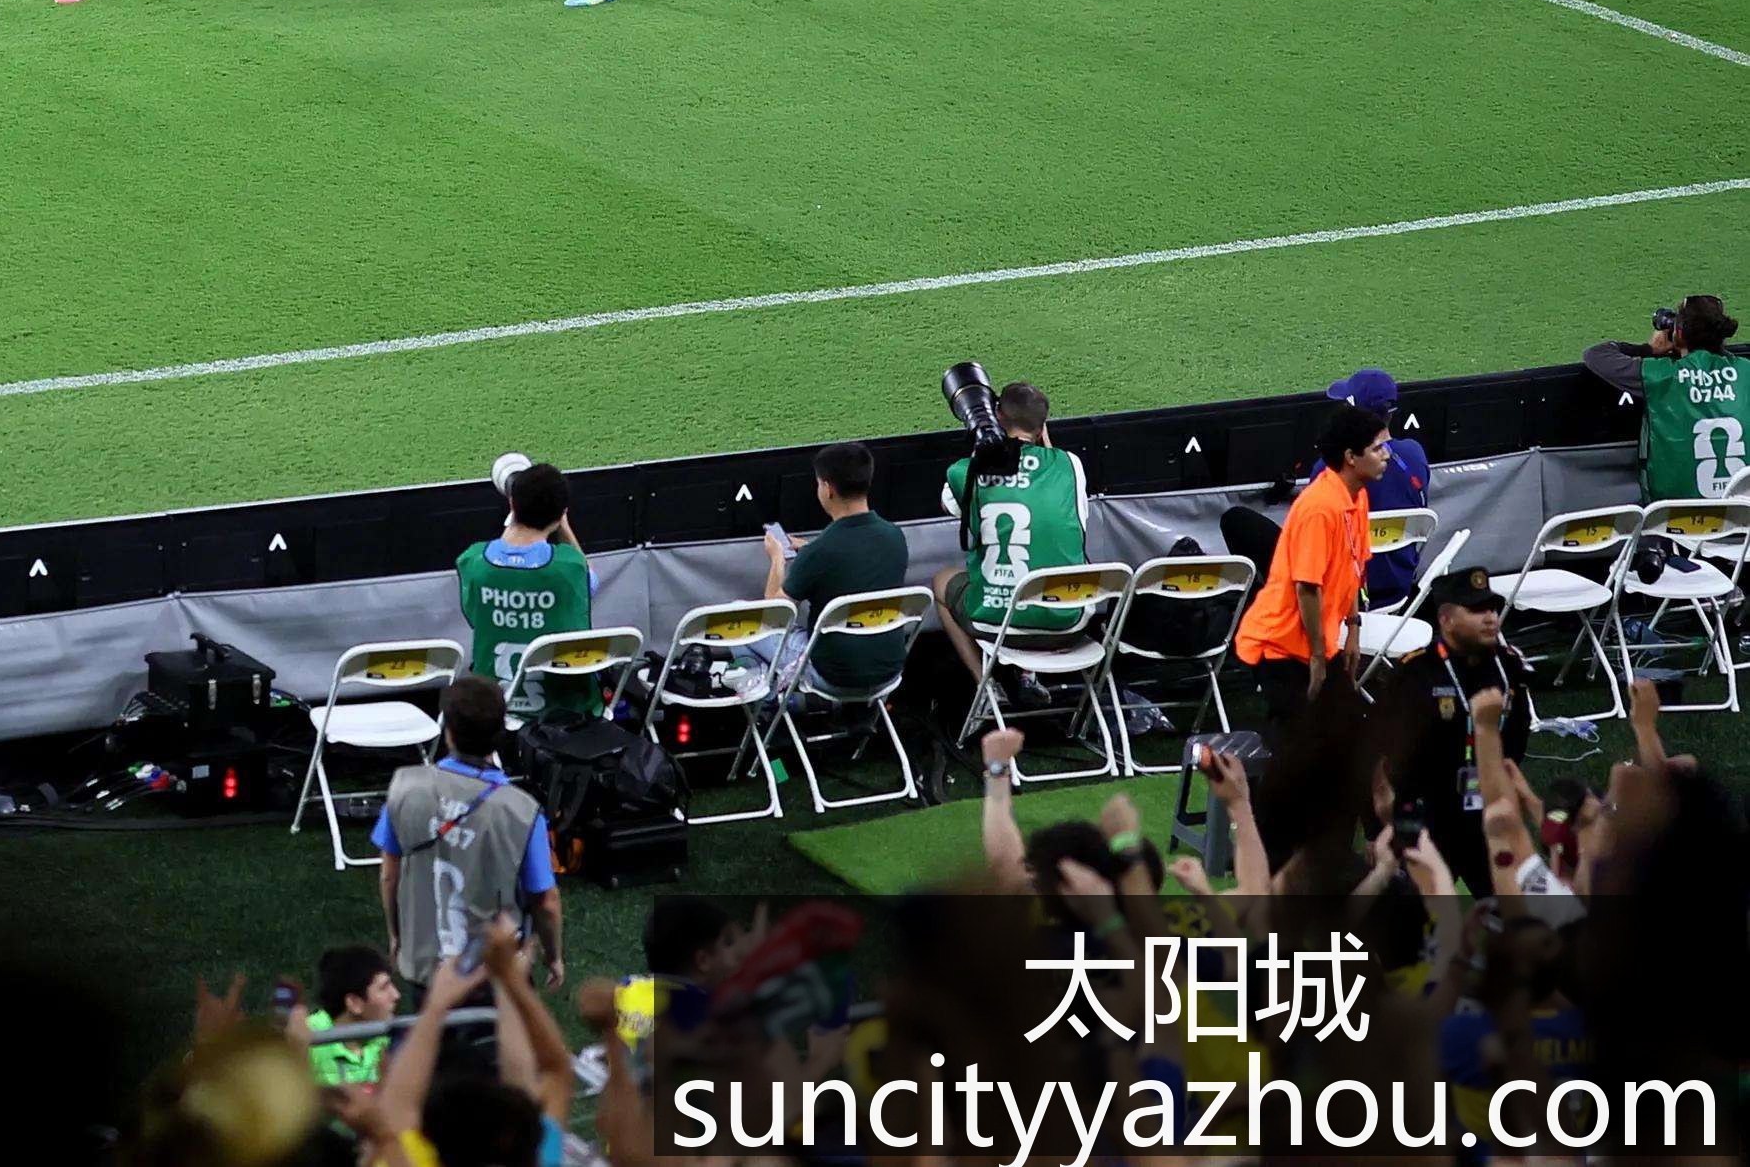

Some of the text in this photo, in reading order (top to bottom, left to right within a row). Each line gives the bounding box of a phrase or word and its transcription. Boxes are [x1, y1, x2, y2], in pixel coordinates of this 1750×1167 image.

[1689, 385, 1736, 404] 0744
[1372, 527, 1388, 538] 16
[993, 568, 1016, 578] FIFA
[481, 586, 556, 610] PHOTO
[492, 609, 546, 630] 0618
